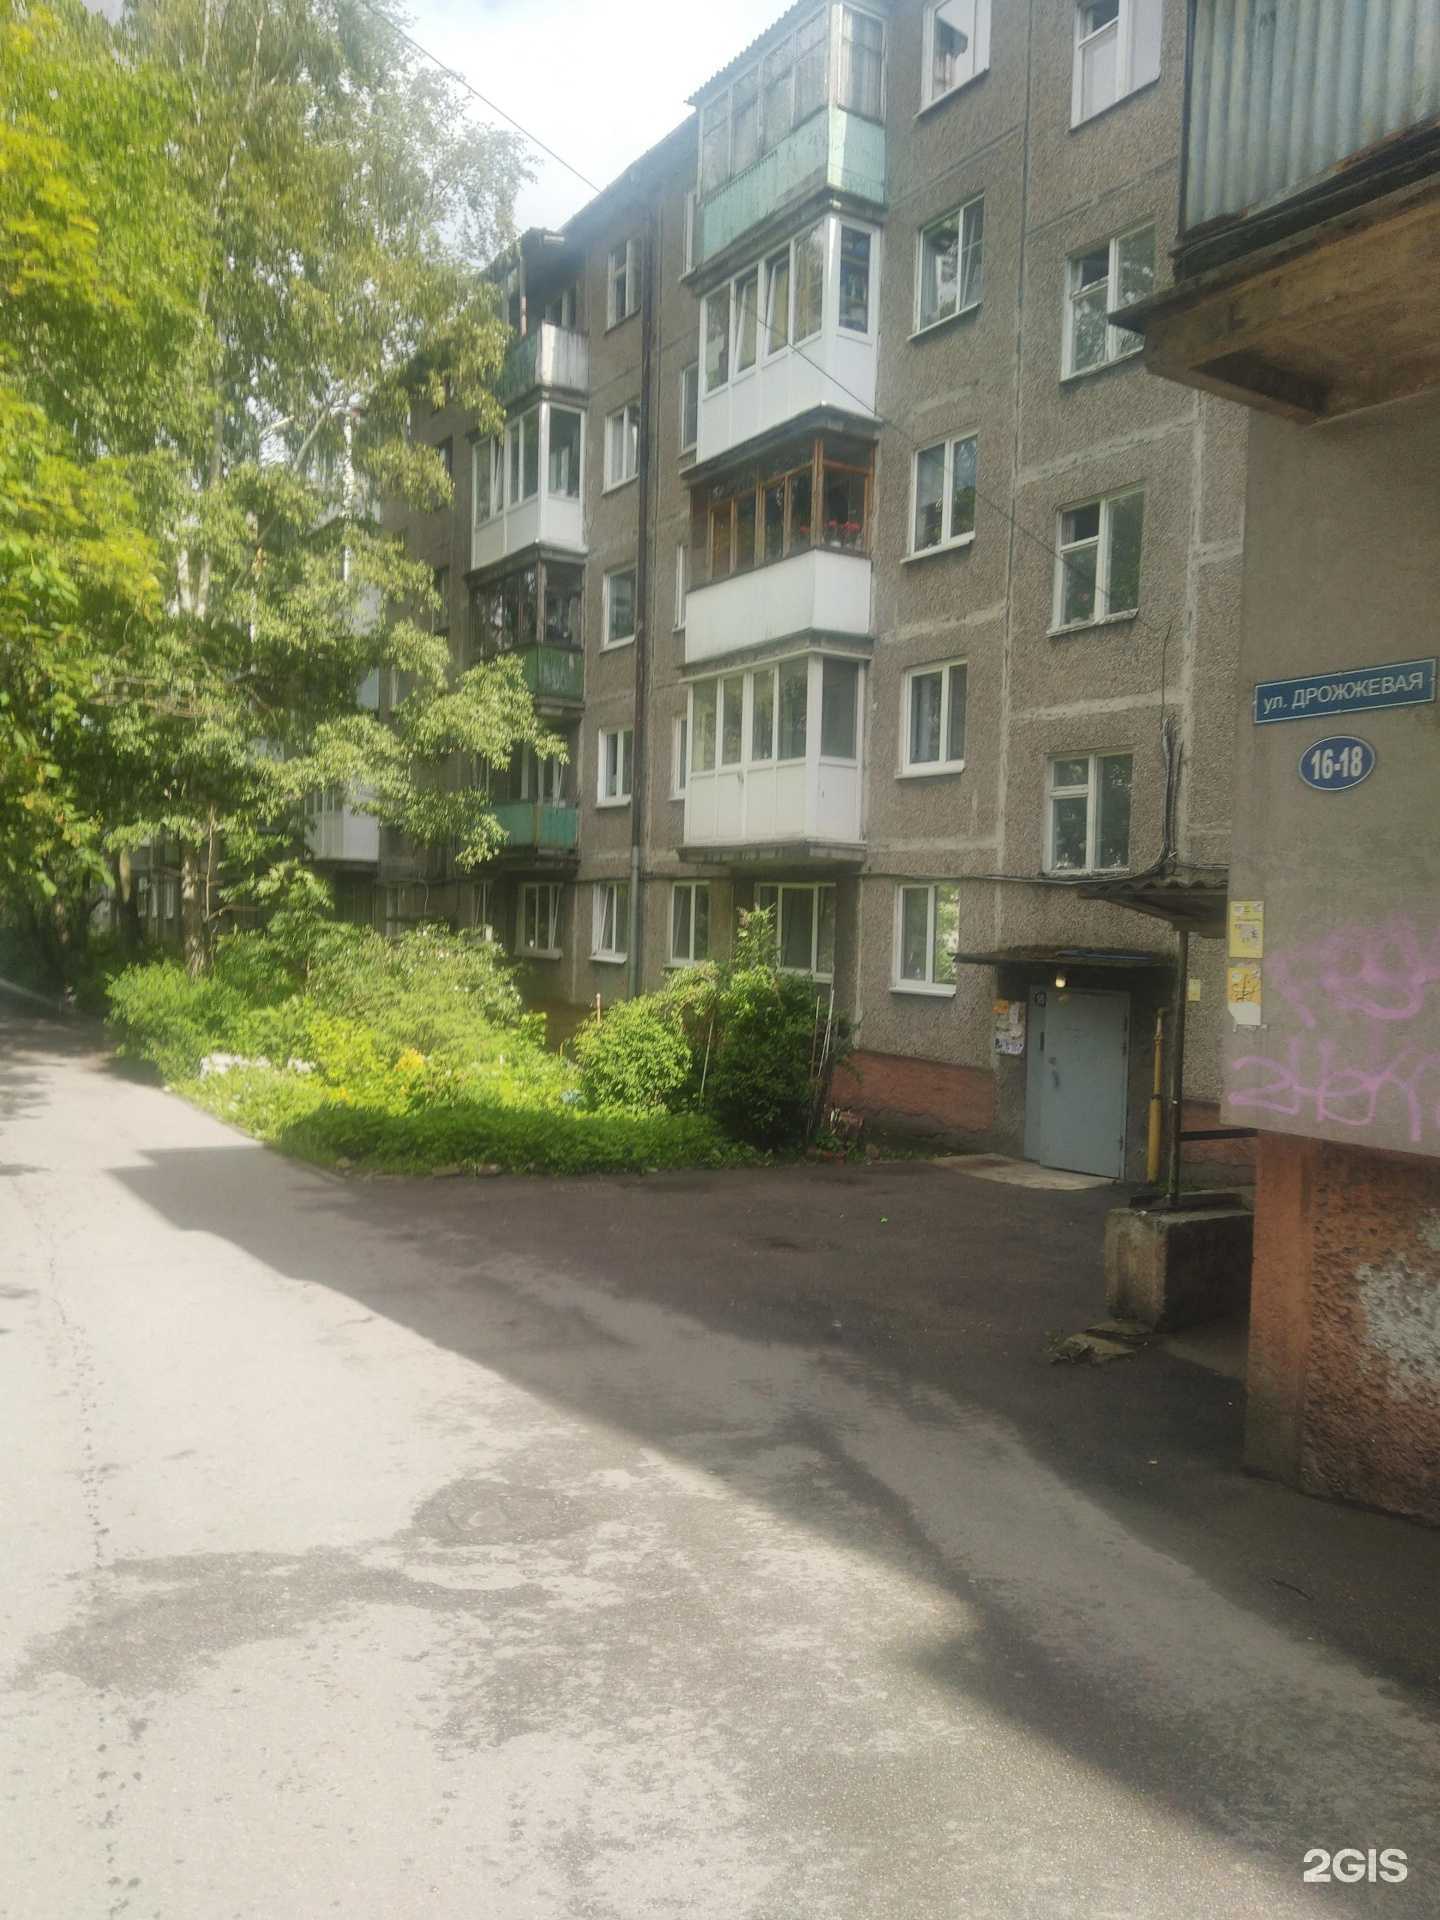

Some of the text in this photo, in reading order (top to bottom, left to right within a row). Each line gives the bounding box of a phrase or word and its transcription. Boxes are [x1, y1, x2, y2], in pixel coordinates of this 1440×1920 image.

[1263, 672, 1424, 714] ул. ДРОЖЖЕВАЯ
[1311, 746, 1363, 779] 16-18
